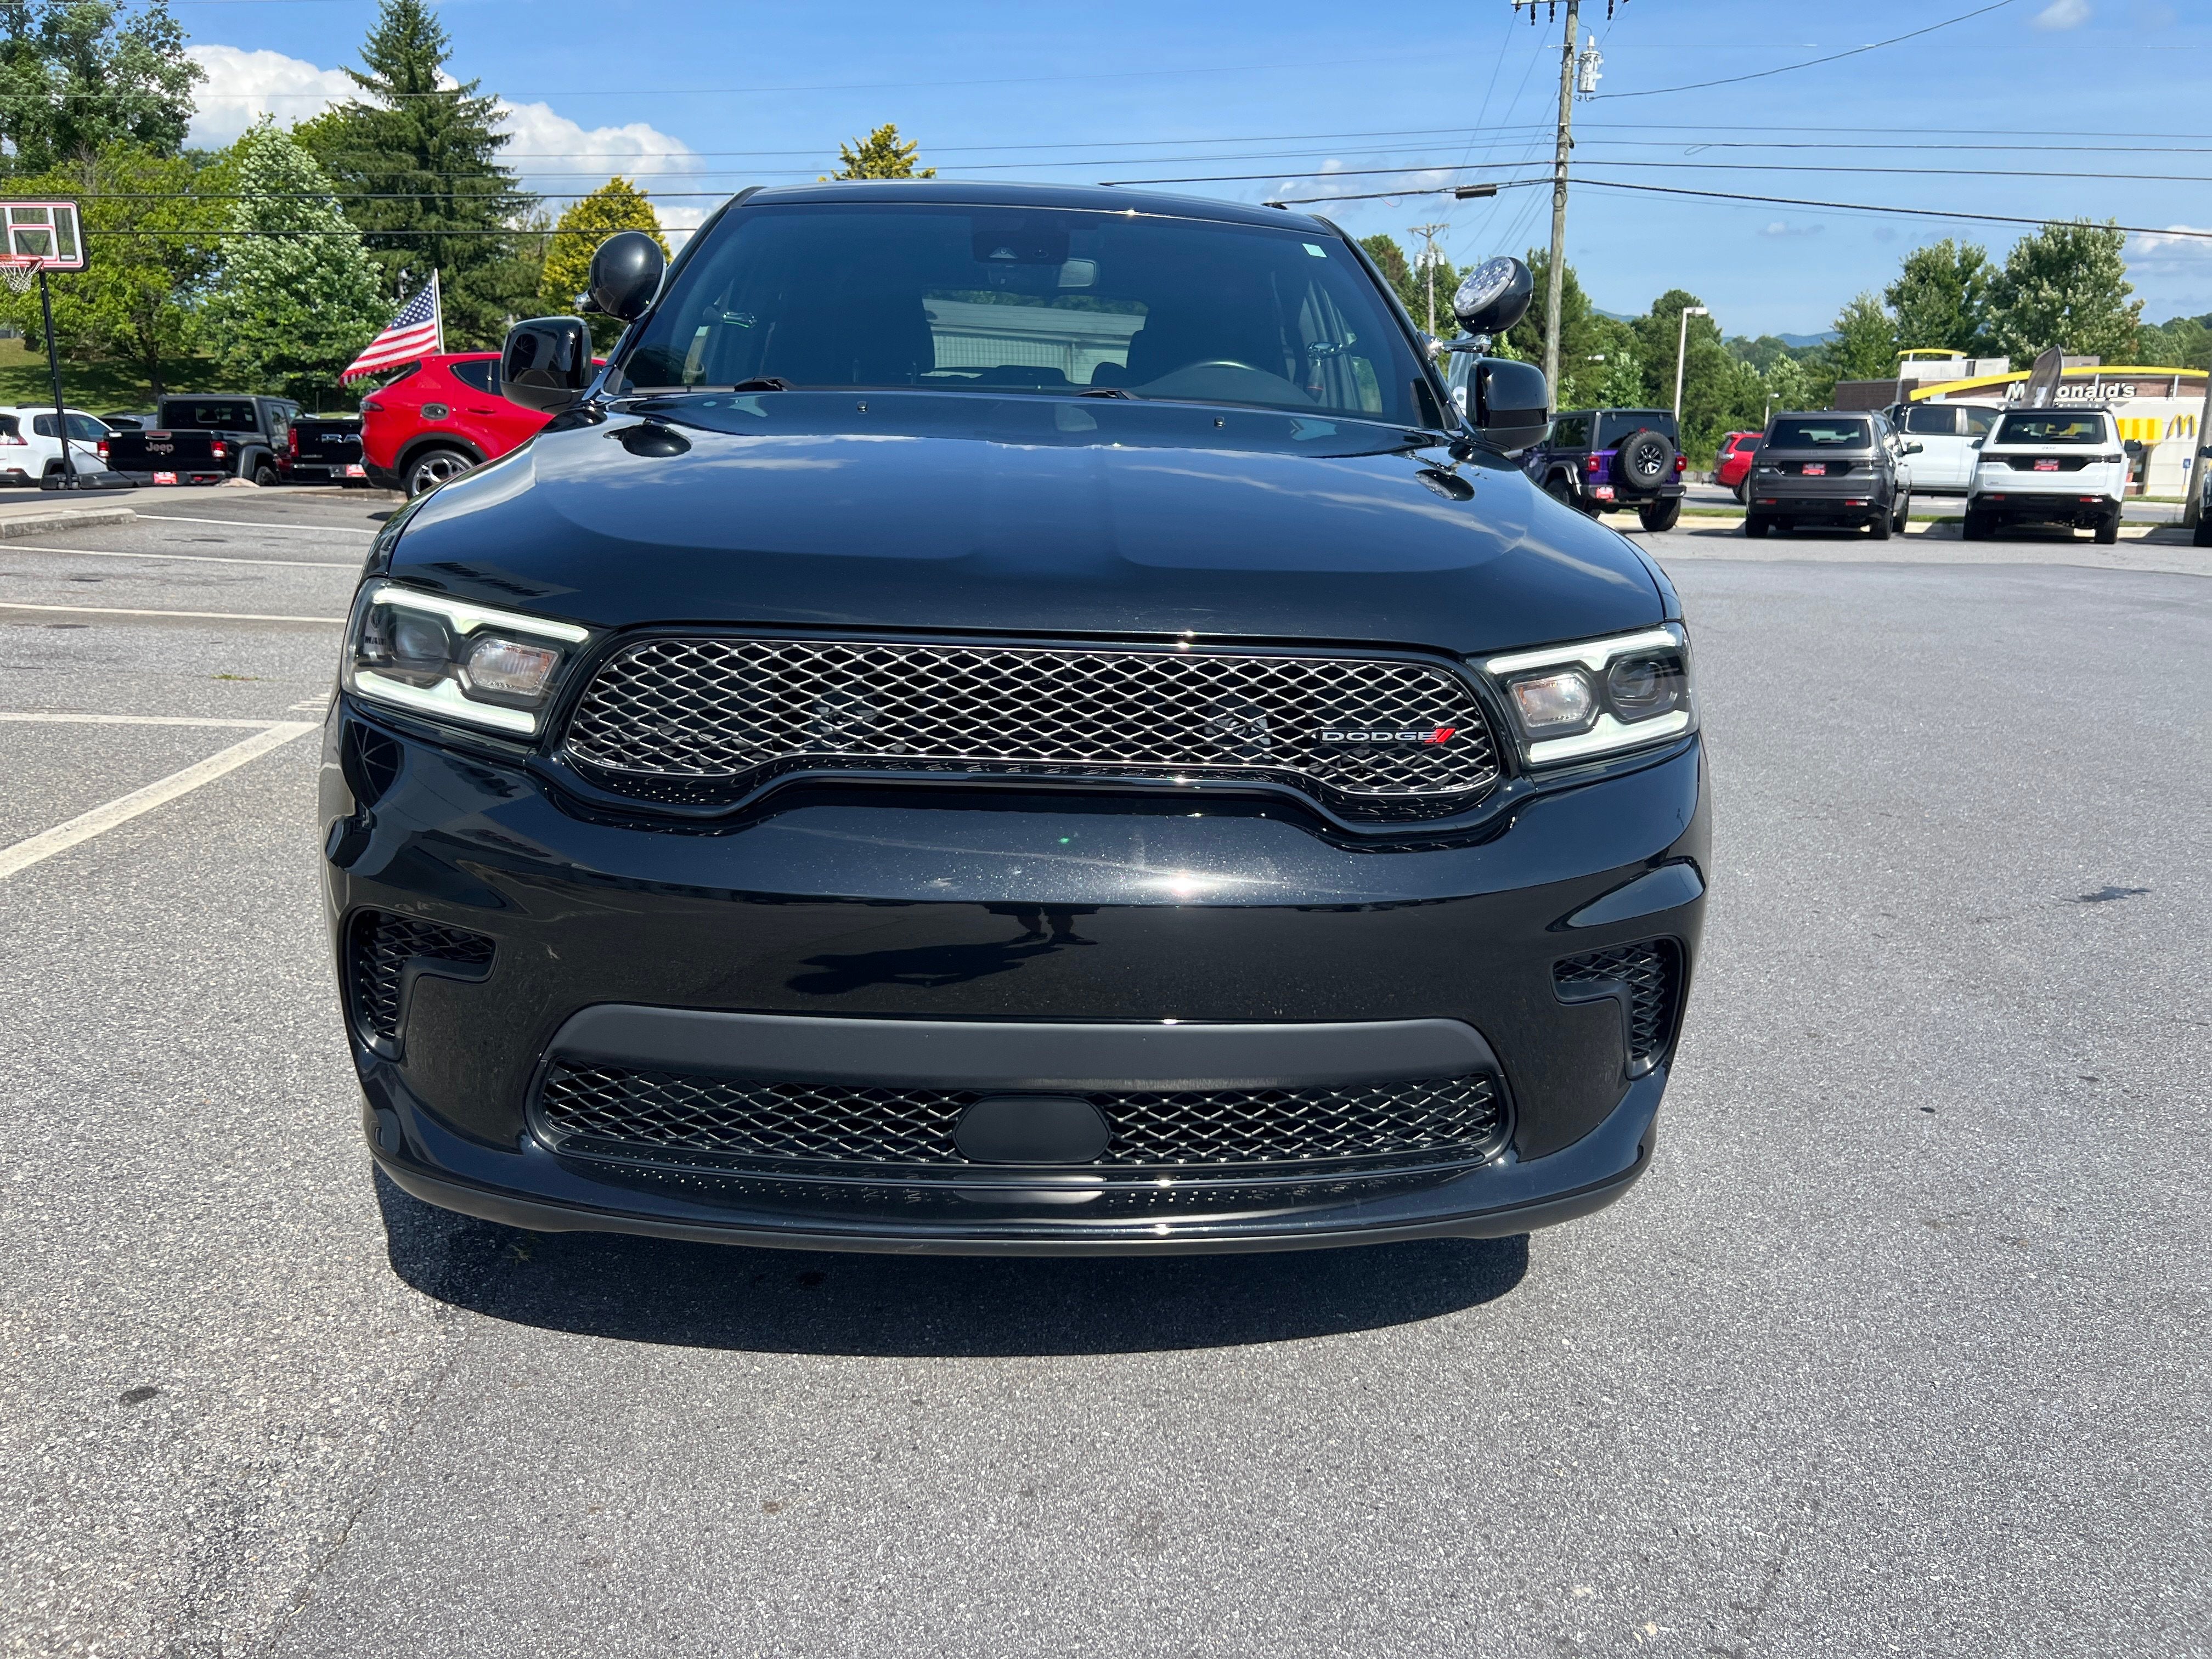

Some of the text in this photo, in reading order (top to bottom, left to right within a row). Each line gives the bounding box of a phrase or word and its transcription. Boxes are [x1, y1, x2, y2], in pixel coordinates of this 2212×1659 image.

[2005, 383, 2135, 399] Monald's
[145, 442, 174, 453] Jeep
[1322, 731, 1437, 741] DODGE
